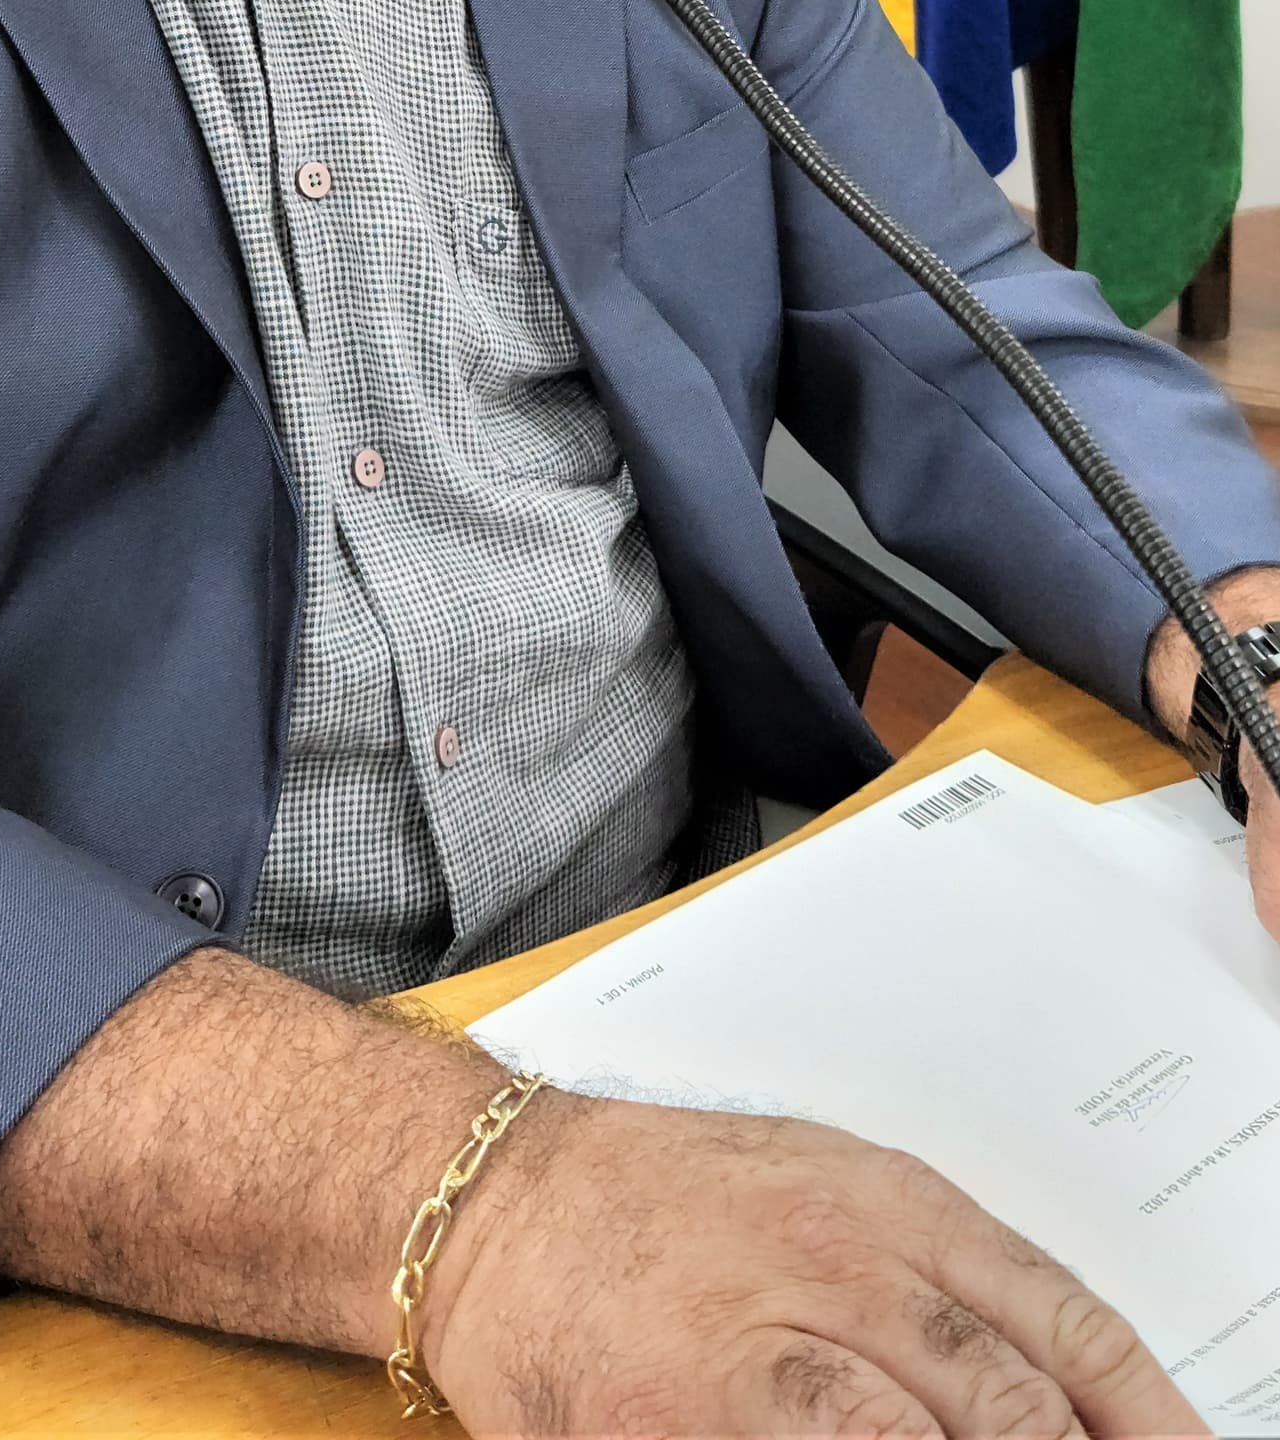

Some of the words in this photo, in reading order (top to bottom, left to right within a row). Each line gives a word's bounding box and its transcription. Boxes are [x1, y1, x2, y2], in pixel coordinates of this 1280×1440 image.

[624, 964, 664, 988] PÁGINA
[602, 988, 622, 1002] DE
[1110, 1048, 1174, 1090] Vereador(a)
[1148, 1054, 1194, 1086] Genilson
[1074, 1090, 1112, 1116] PODE
[1128, 1084, 1154, 1102] José
[1114, 1098, 1138, 1112] da
[1088, 1106, 1124, 1128] Silva
[1224, 1108, 1280, 1146] SESSÕES,
[1200, 1156, 1218, 1166] de
[1212, 1146, 1232, 1158] 18
[1176, 1164, 1204, 1186] abril
[1162, 1184, 1180, 1196] de
[1138, 1192, 1168, 1214] 2022
[1208, 1316, 1250, 1344] mesma
